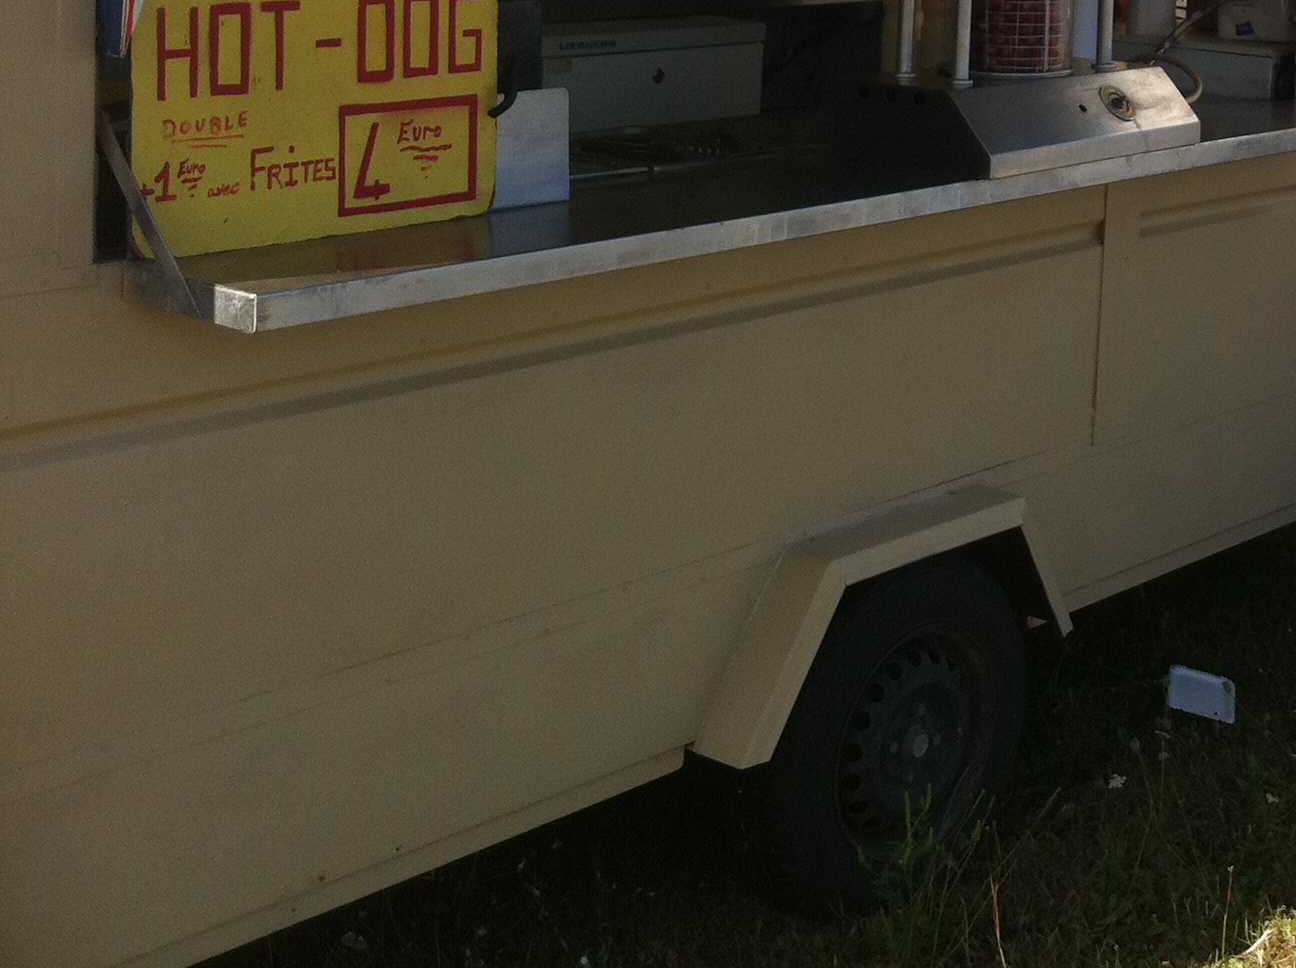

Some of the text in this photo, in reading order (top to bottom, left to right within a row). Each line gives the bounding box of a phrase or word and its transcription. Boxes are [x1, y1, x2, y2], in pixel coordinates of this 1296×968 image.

[162, 110, 249, 140] DOUBLE
[397, 118, 443, 145] Euro
[177, 158, 207, 179] Euro
